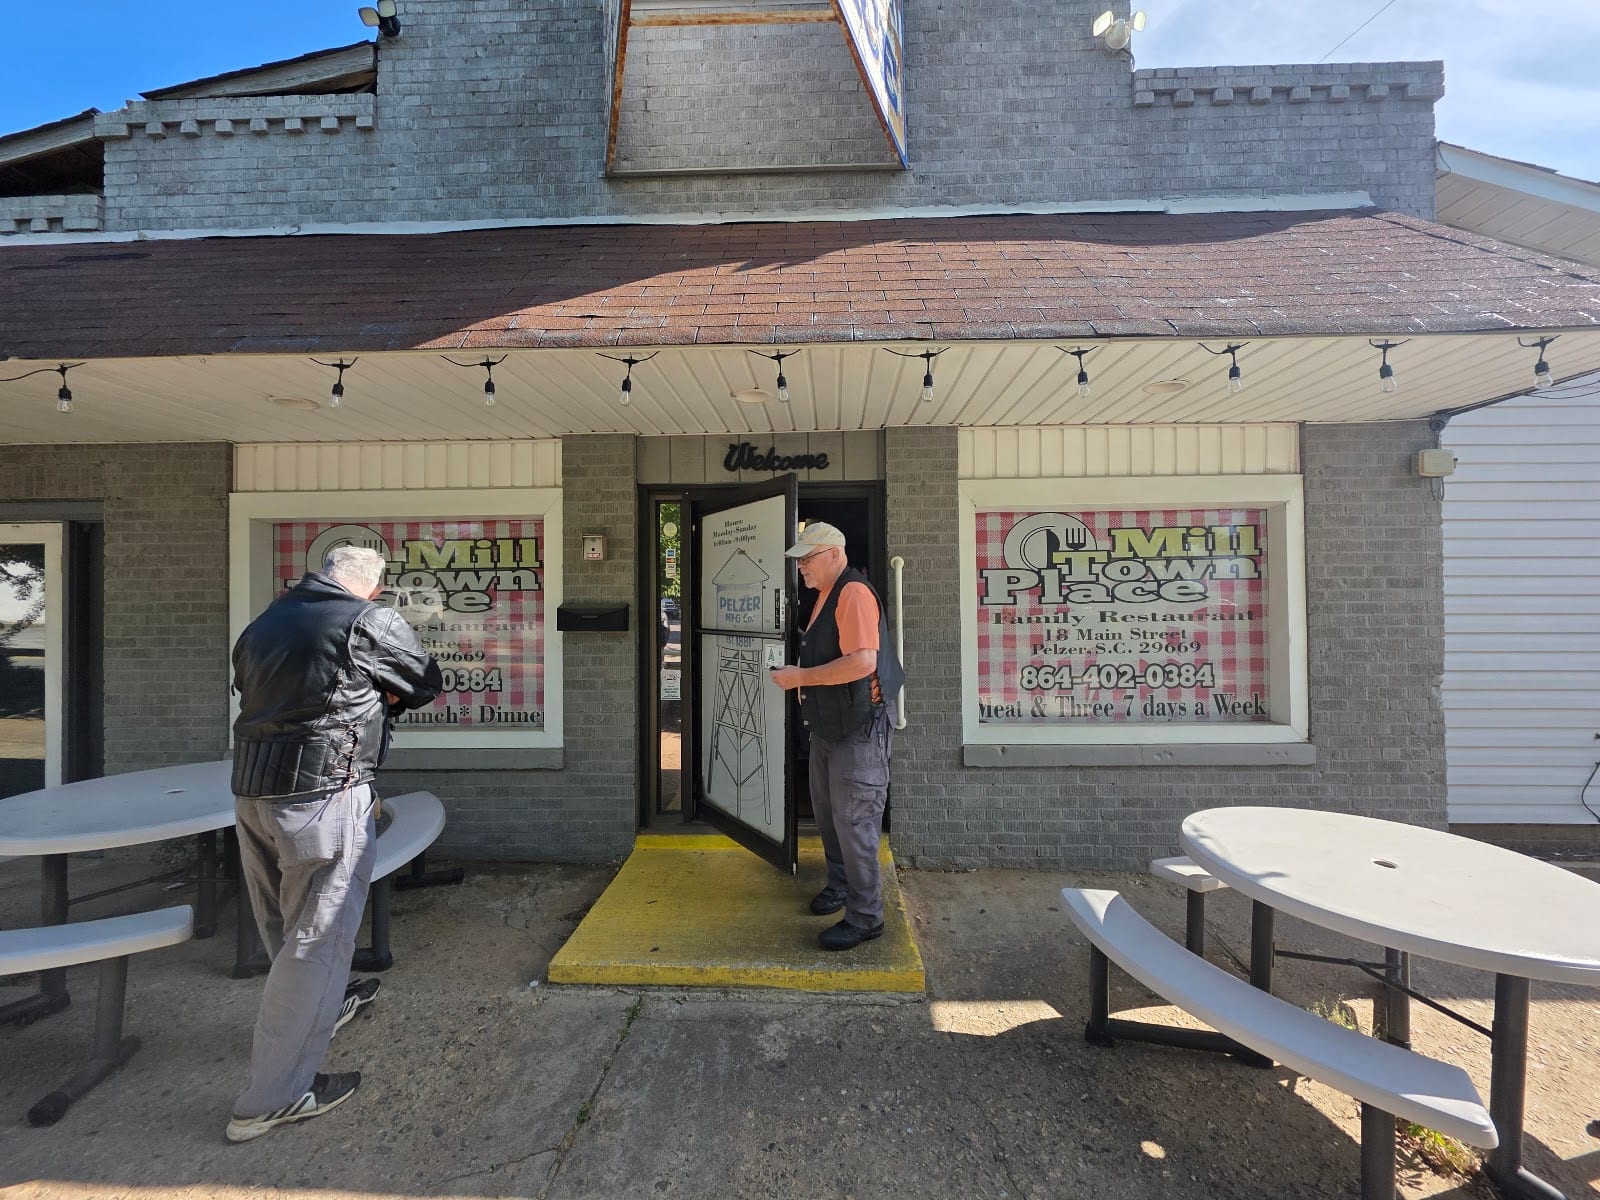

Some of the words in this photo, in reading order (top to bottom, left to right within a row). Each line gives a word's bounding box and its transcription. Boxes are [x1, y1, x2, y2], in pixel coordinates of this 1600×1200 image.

[724, 442, 829, 472] Welcome
[401, 538, 541, 570] Mill
[1108, 525, 1262, 559] Mill
[1052, 550, 1262, 582] Town
[980, 567, 1210, 605] Place
[719, 596, 761, 612] PELZER
[408, 619, 536, 632] estaurant
[992, 611, 1086, 627] Family
[1099, 610, 1254, 623] Restaurant
[421, 637, 473, 650] Street
[1044, 628, 1069, 641] 18
[1077, 628, 1121, 641] Main
[1130, 627, 1187, 641] Street
[1139, 640, 1201, 654] 29669
[1020, 662, 1215, 690] 864-402-0384
[1030, 695, 1048, 718] &
[1055, 695, 1114, 718] Three
[1123, 694, 1134, 717] 7
[1143, 694, 1187, 722] days
[1194, 701, 1206, 716] a
[1212, 692, 1267, 716] Week
